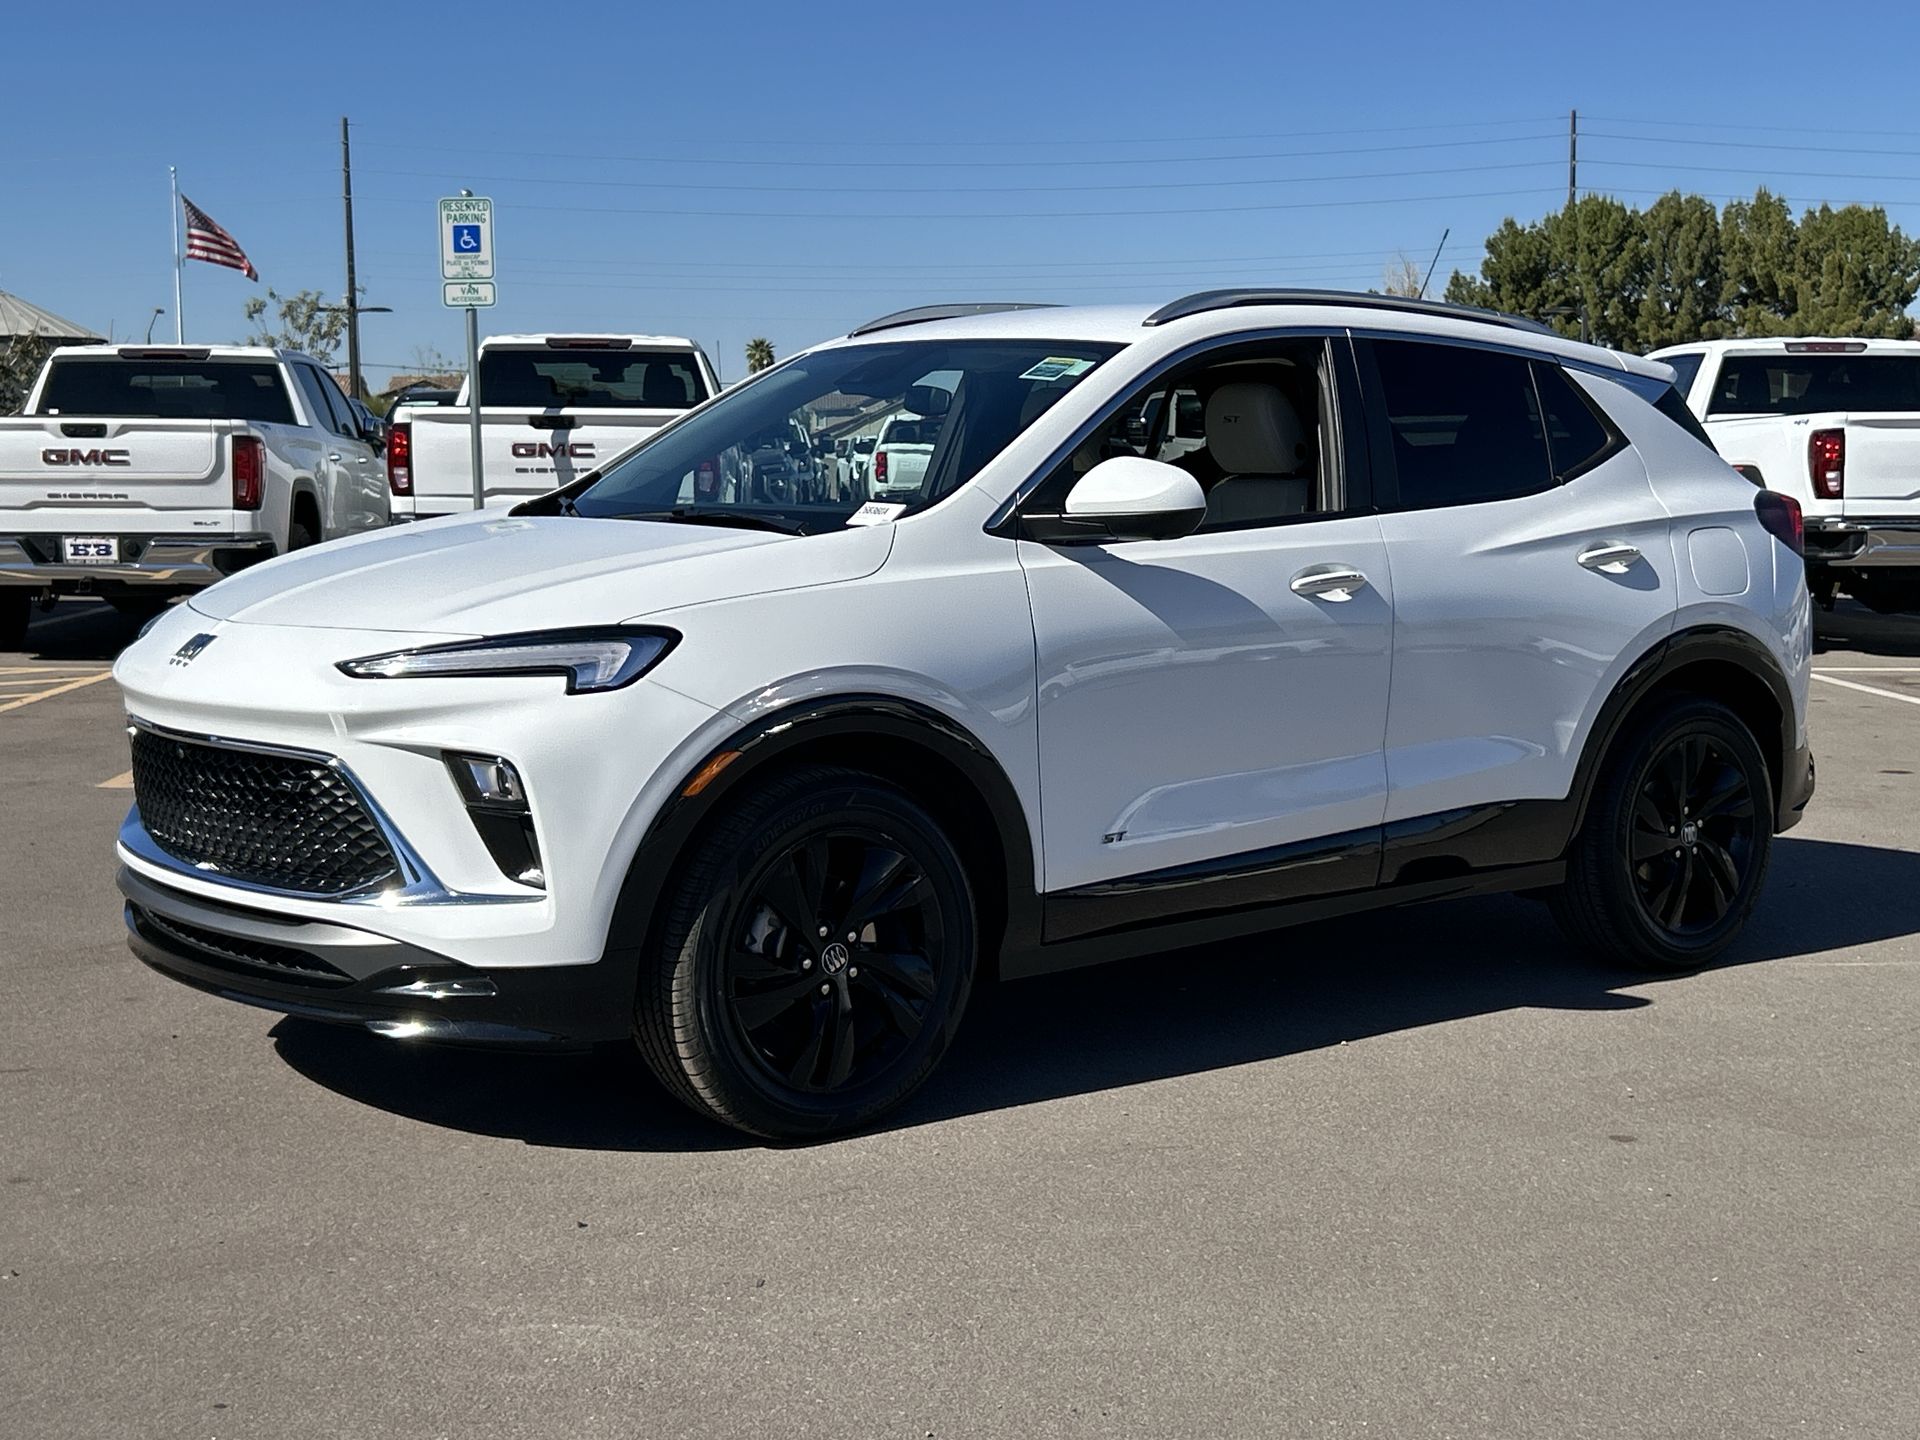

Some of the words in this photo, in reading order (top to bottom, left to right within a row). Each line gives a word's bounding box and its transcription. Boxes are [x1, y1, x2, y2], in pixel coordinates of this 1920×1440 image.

[443, 201, 489, 211] RESERVED
[446, 213, 487, 223] PARKING
[460, 287, 479, 295] VAN
[1223, 415, 1241, 424] ST
[512, 443, 596, 458] GMC
[42, 448, 131, 466] GMC
[1101, 830, 1128, 845] ST
